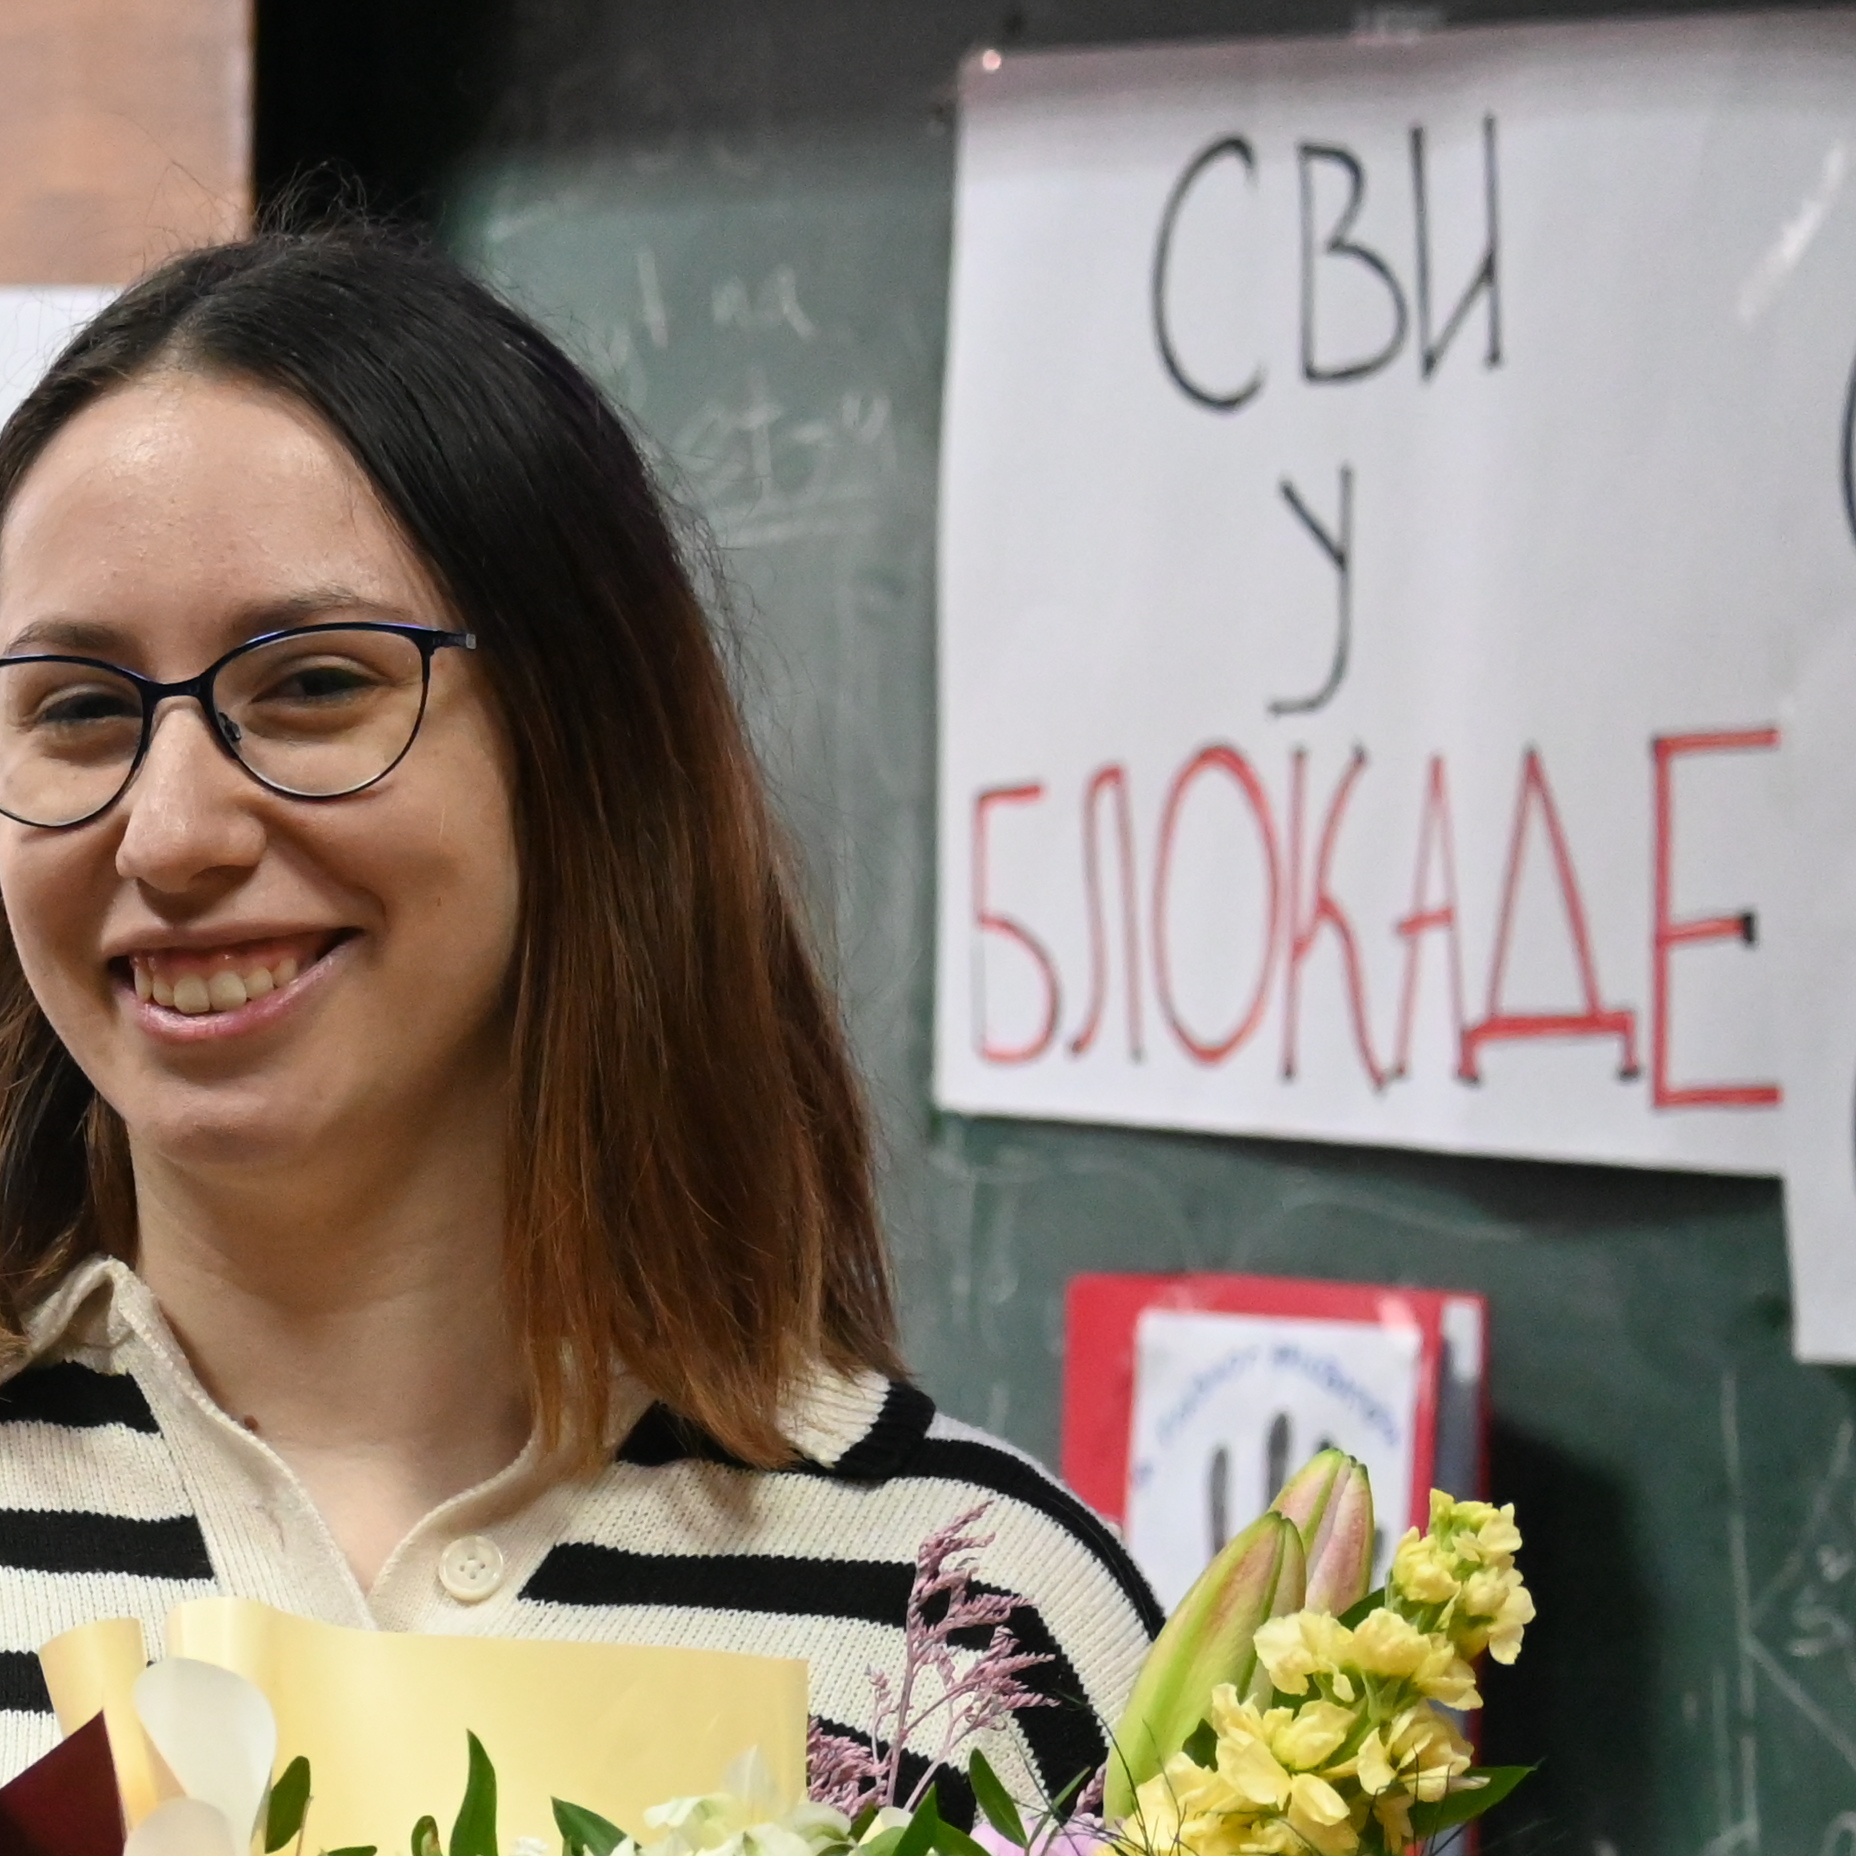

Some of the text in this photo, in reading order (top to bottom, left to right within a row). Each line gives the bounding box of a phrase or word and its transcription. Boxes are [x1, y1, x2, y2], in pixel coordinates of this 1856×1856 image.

[1149, 111, 1505, 414] СВИ
[1267, 462, 1355, 719] У
[971, 726, 1782, 1110] БЛОКАДЕ
